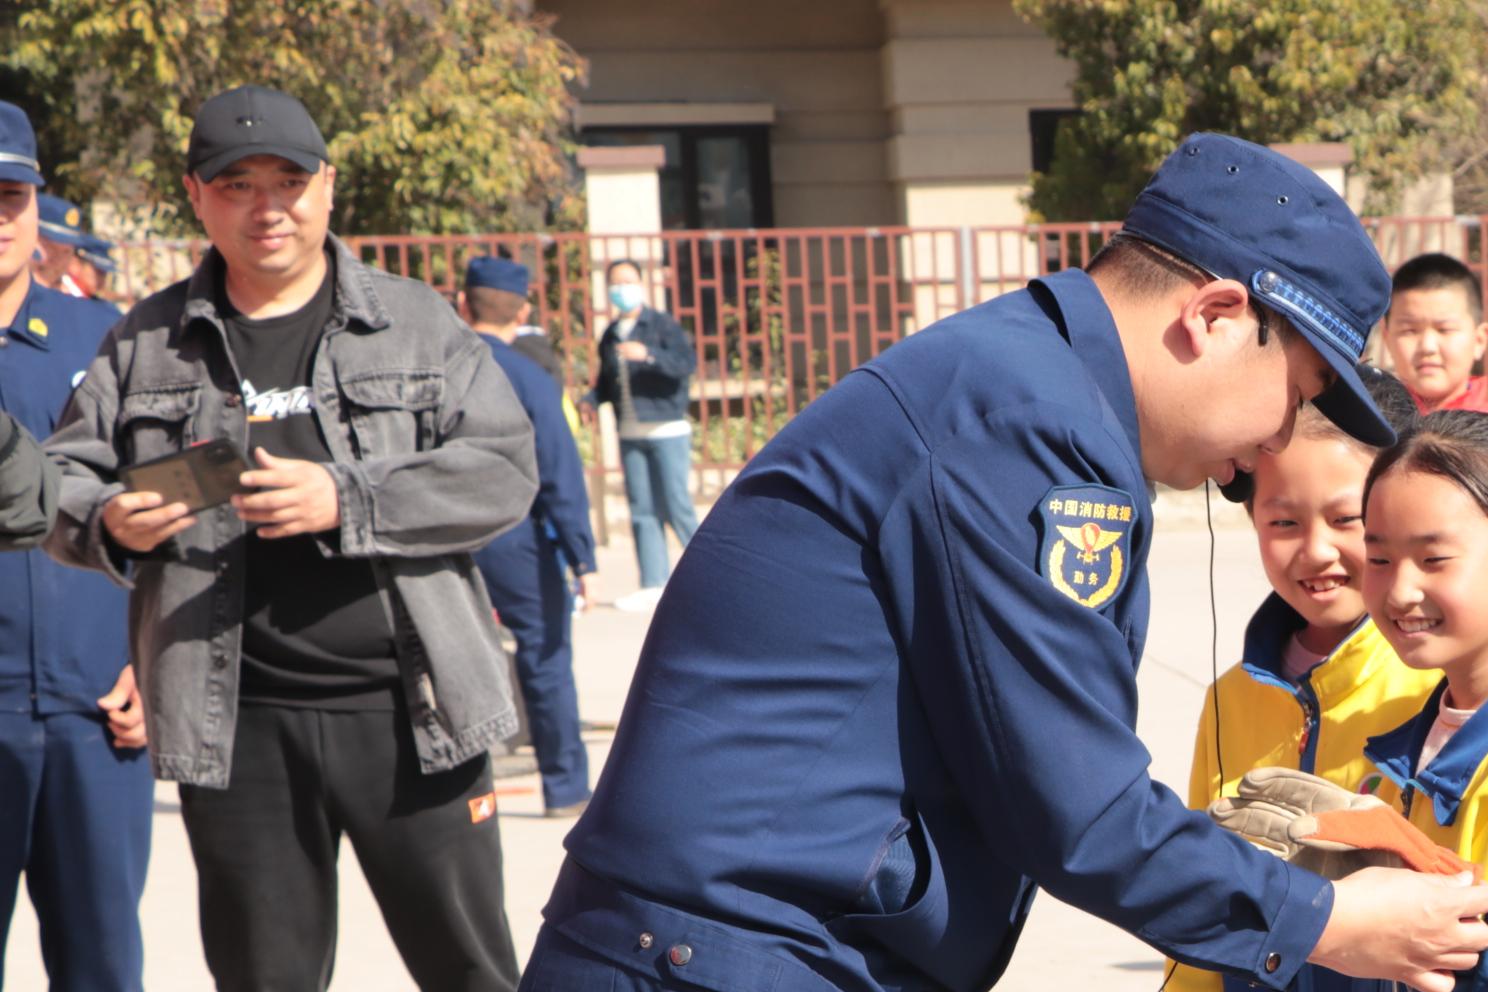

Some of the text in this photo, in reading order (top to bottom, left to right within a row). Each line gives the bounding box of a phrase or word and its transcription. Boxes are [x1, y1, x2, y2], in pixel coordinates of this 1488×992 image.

[1049, 498, 1131, 522] 中国消防救援
